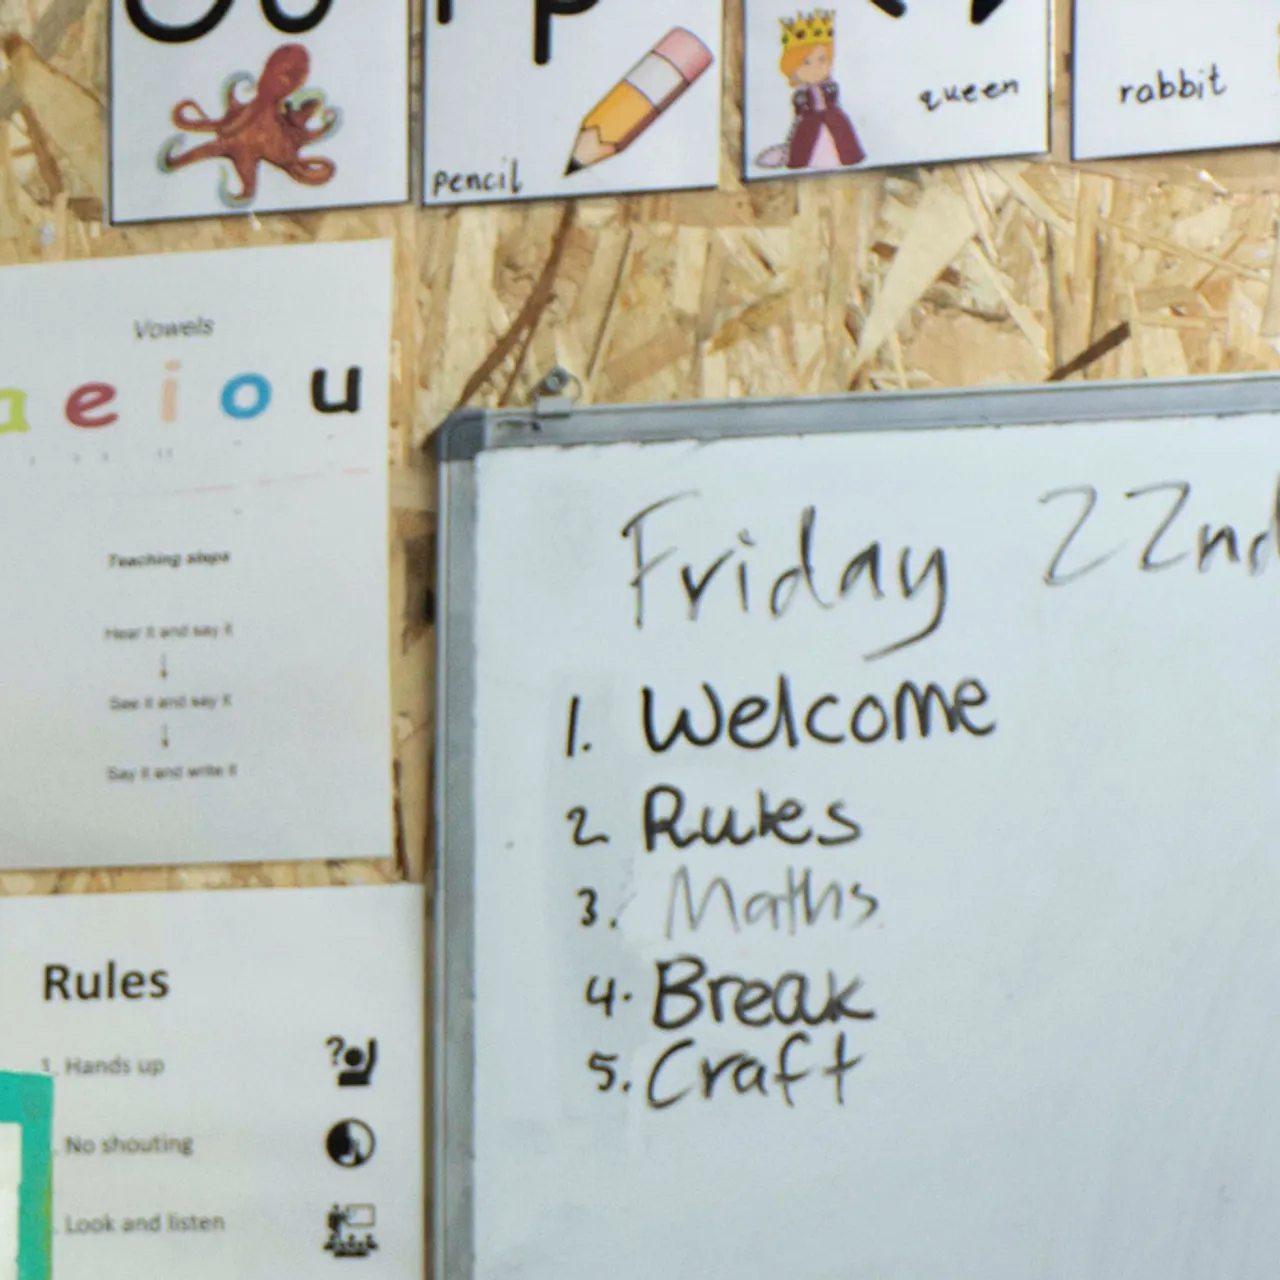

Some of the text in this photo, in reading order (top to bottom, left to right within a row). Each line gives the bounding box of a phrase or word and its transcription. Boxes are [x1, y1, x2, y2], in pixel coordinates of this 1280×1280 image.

[918, 77, 1020, 112] queen
[1117, 63, 1227, 105] rabbit
[433, 160, 523, 195] pencil
[134, 317, 215, 341] Vowels
[64, 382, 119, 429] e
[160, 358, 182, 423] i
[220, 372, 273, 419] o
[310, 366, 363, 415] u
[108, 552, 182, 569] Teaching
[621, 488, 950, 662] Friday
[640, 672, 998, 755] Welcome
[643, 783, 863, 853] Rules
[664, 863, 881, 942] Maths
[42, 961, 170, 1001] Rules
[651, 953, 877, 1031] Break
[65, 1055, 132, 1076] Hands
[138, 1058, 166, 1077] up
[646, 1030, 864, 1109] Craft
[65, 1133, 194, 1158] No shouting
[65, 1211, 226, 1234] Look and listen
